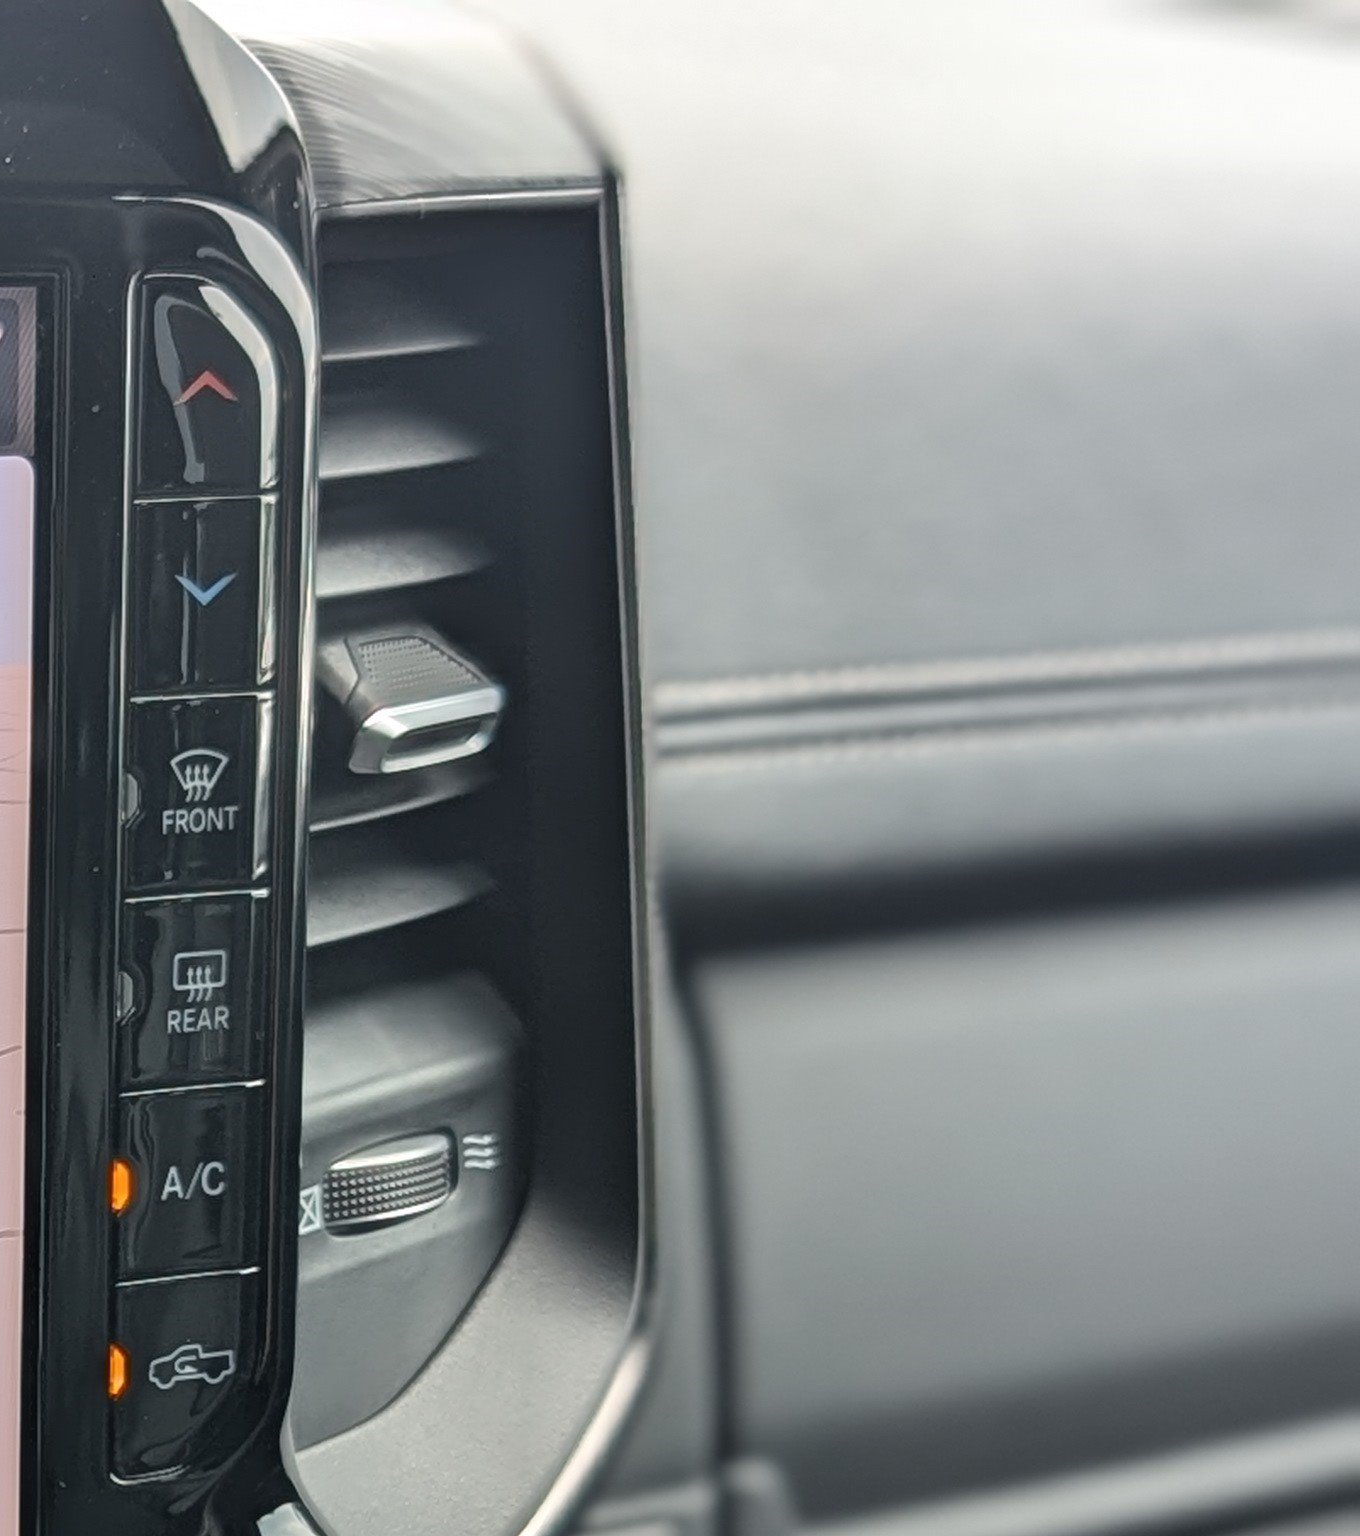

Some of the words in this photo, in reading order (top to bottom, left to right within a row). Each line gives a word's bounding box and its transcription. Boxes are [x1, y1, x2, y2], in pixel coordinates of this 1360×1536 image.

[162, 806, 240, 835] FRONT
[167, 1007, 230, 1034] REAR
[162, 1160, 227, 1202] A/C
